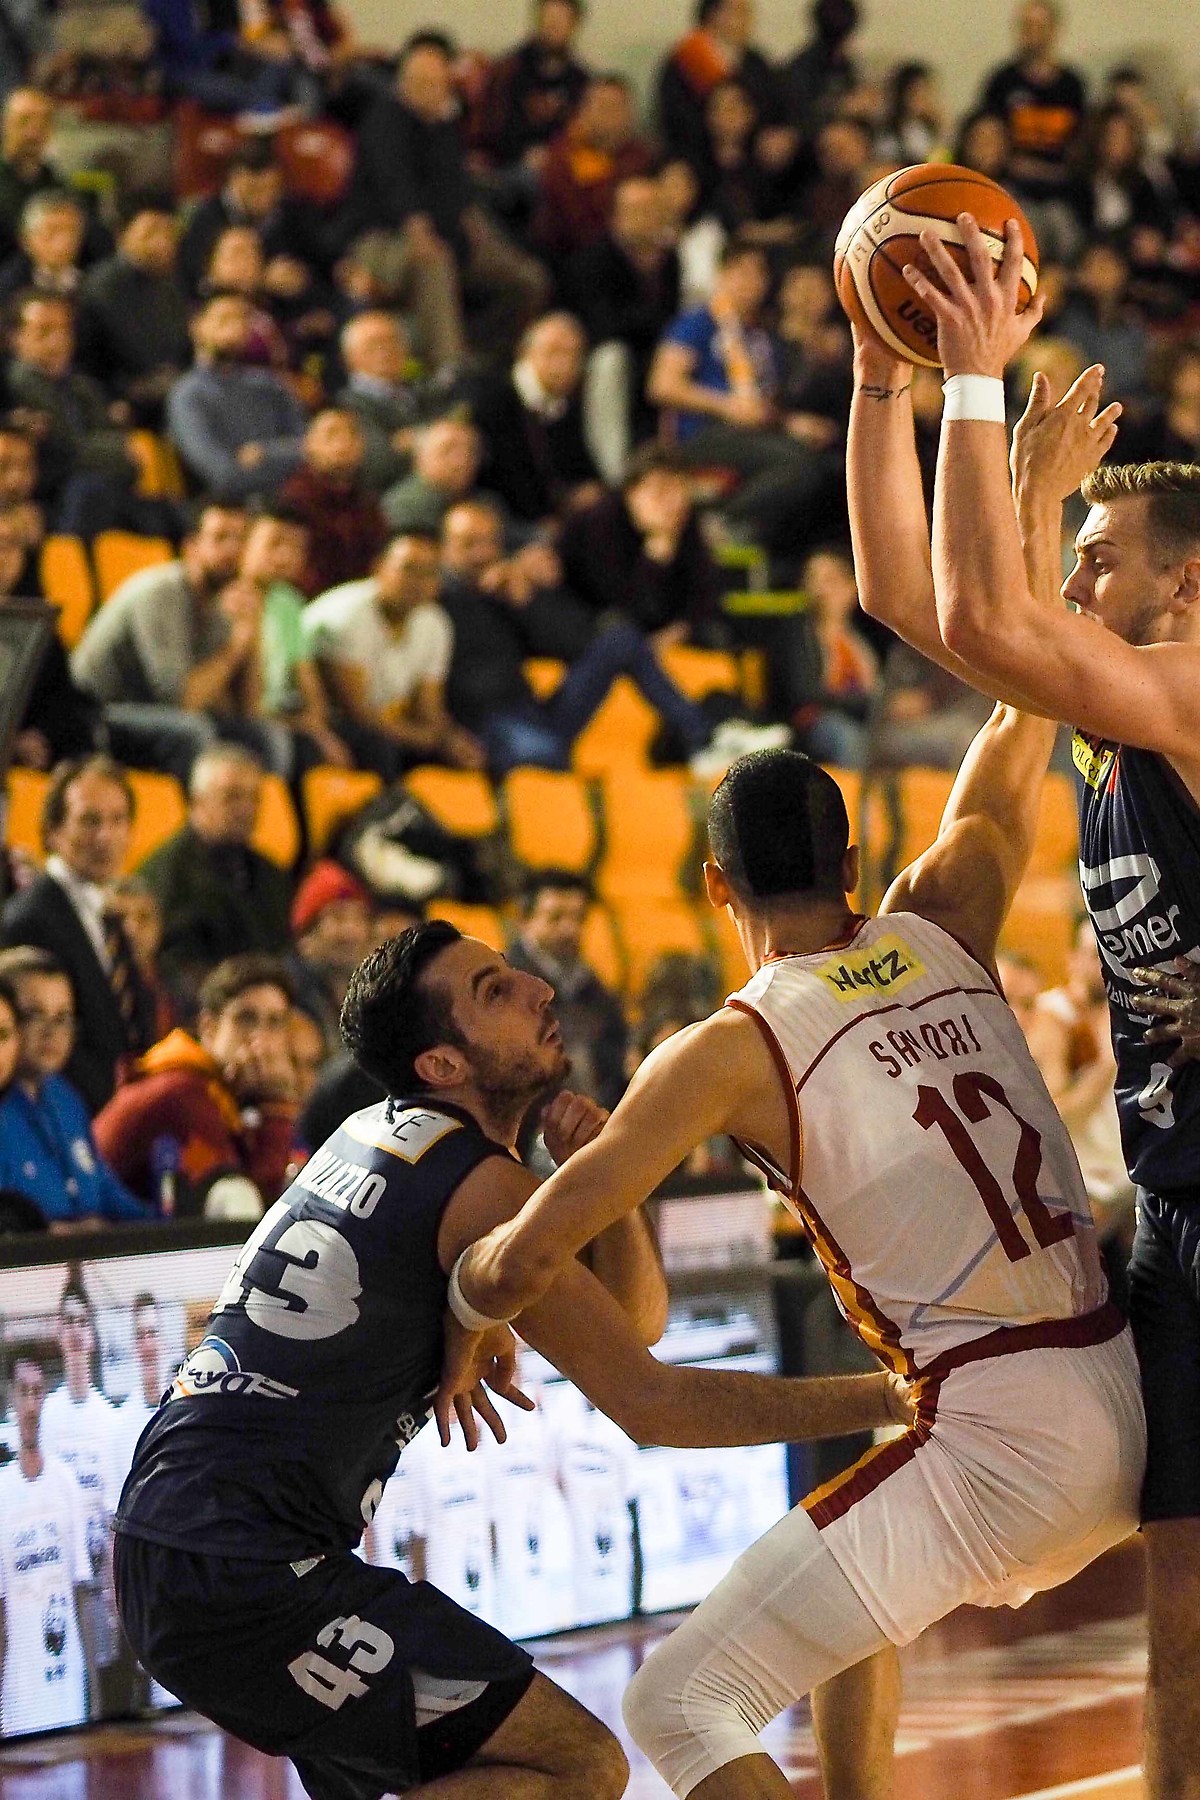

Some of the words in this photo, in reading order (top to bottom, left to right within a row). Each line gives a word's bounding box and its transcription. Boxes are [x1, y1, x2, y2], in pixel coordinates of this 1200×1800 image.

[828, 949, 908, 991] Hertz
[912, 1071, 1076, 1263] 12
[287, 1614, 395, 1711] 43
